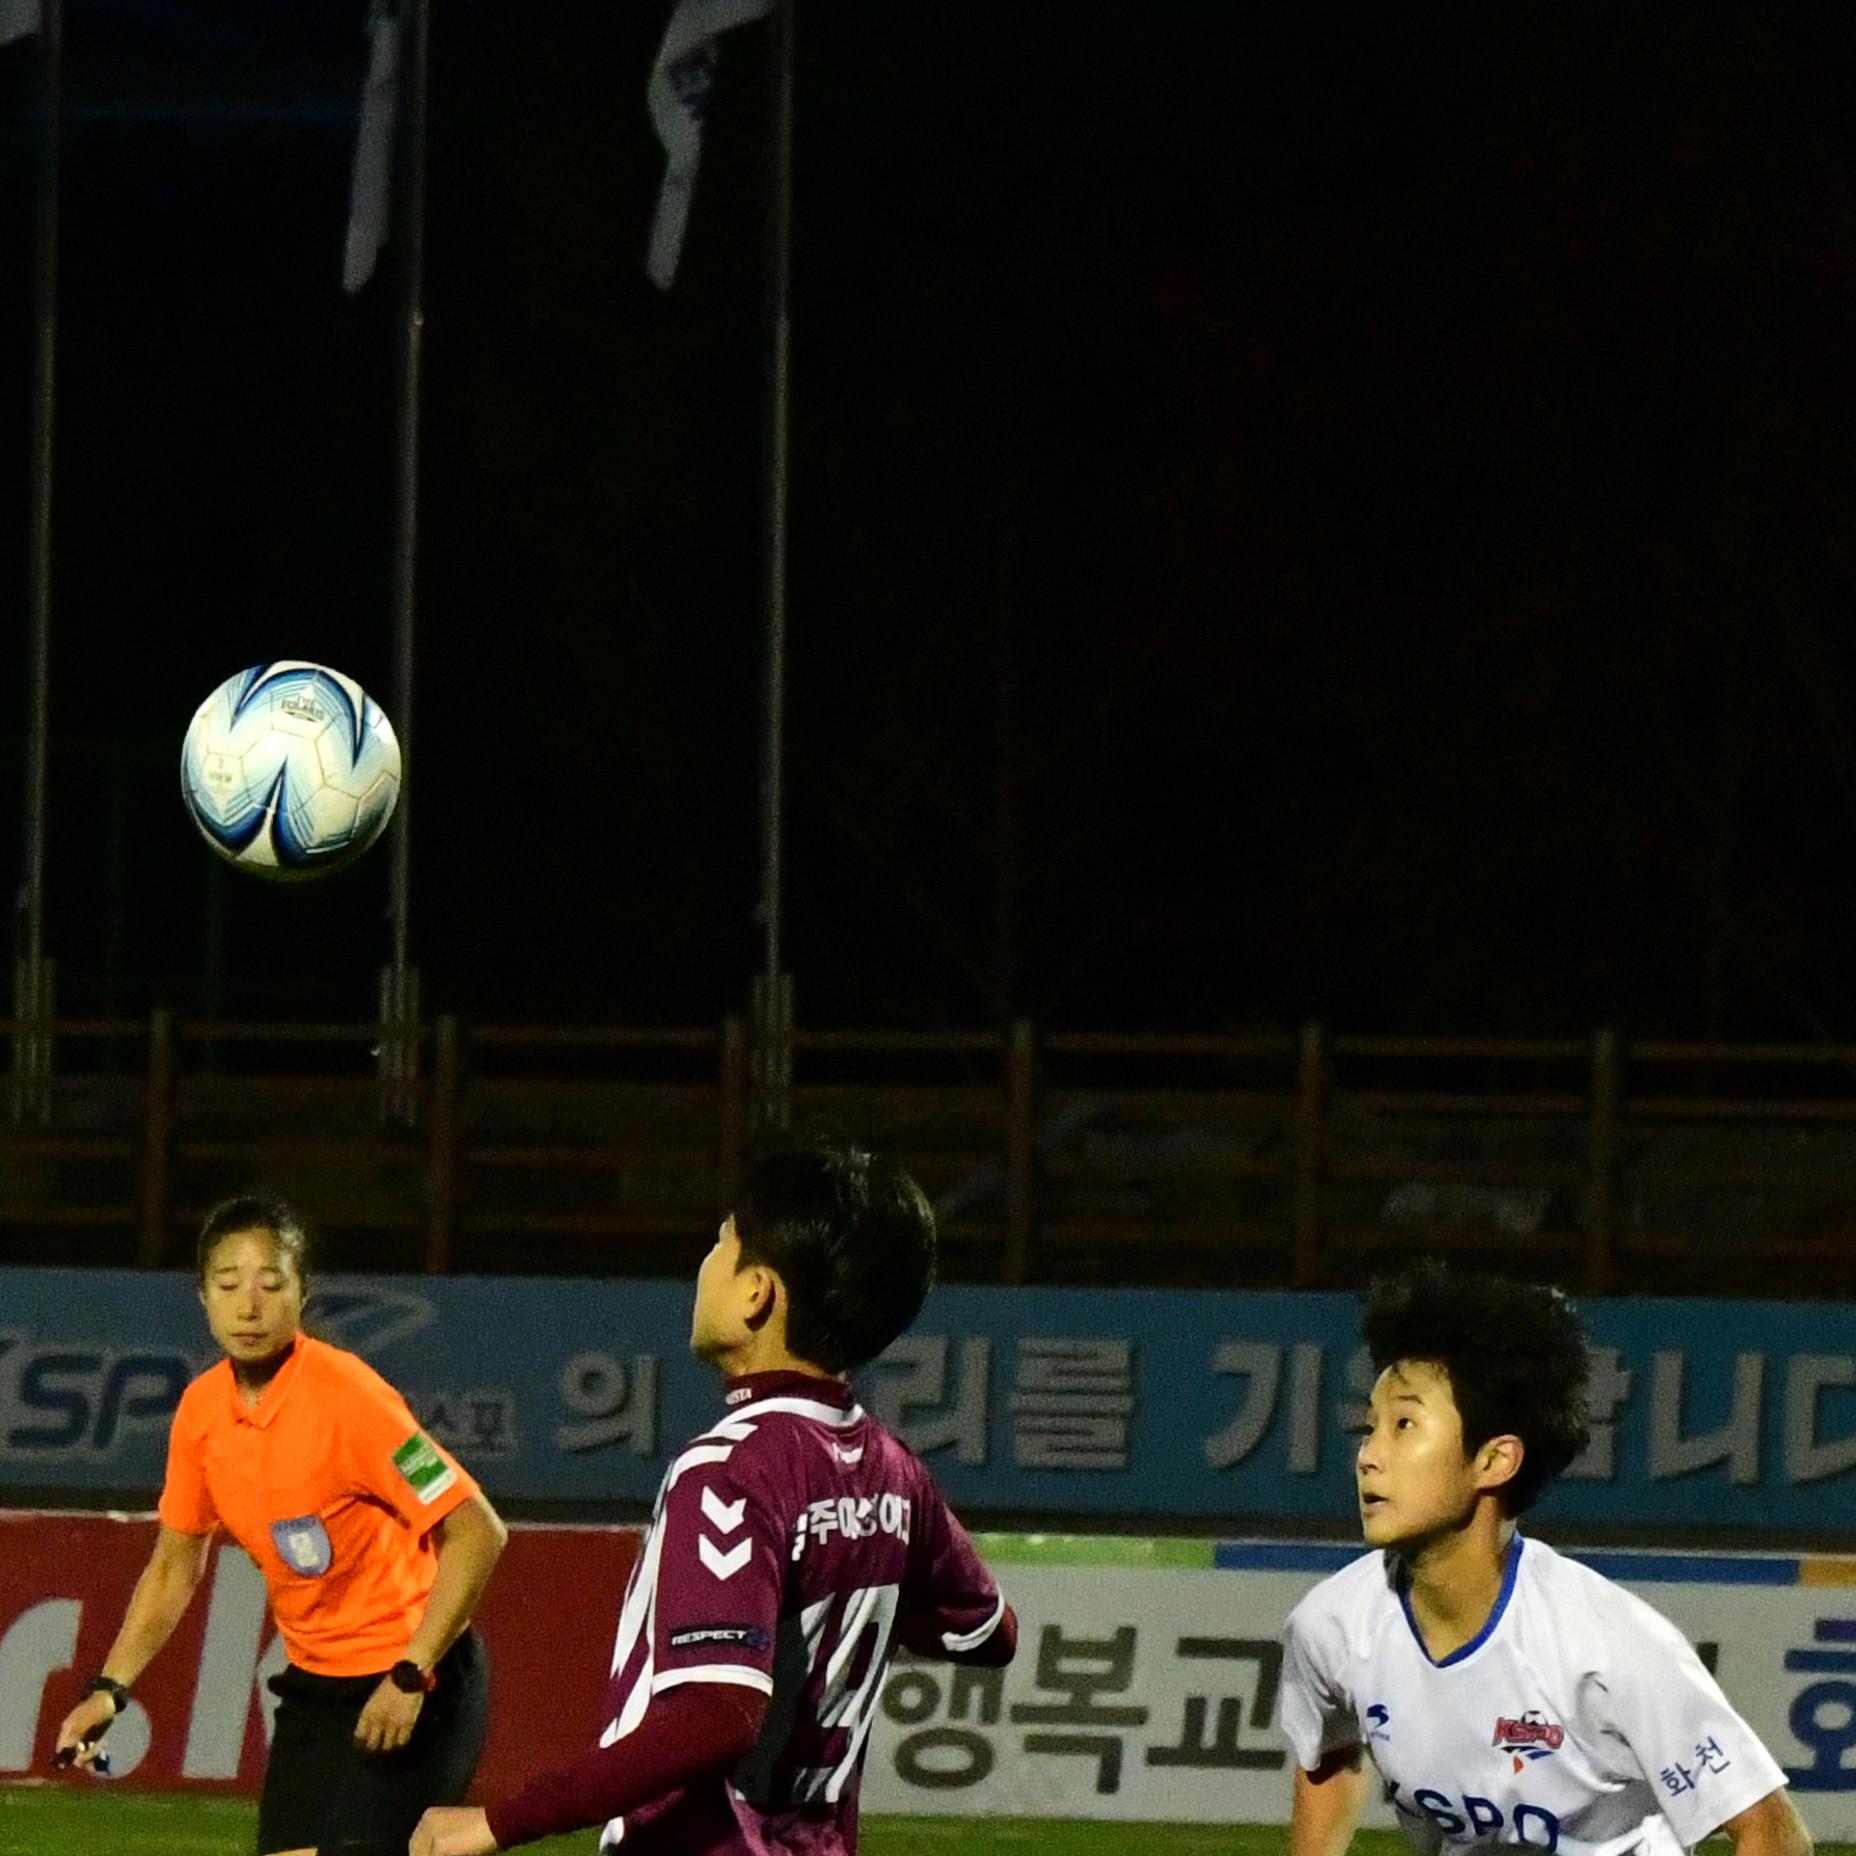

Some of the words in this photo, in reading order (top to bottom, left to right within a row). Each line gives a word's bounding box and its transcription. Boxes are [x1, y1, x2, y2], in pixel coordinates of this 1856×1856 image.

[554, 1352, 656, 1456] 의
[874, 1336, 1134, 1468] 리를
[671, 1629, 747, 1647] RESPECT
[883, 1624, 1286, 1794] 행복교
[1659, 1736, 1730, 1797] 화천
[1390, 1786, 1560, 1855] SPO
